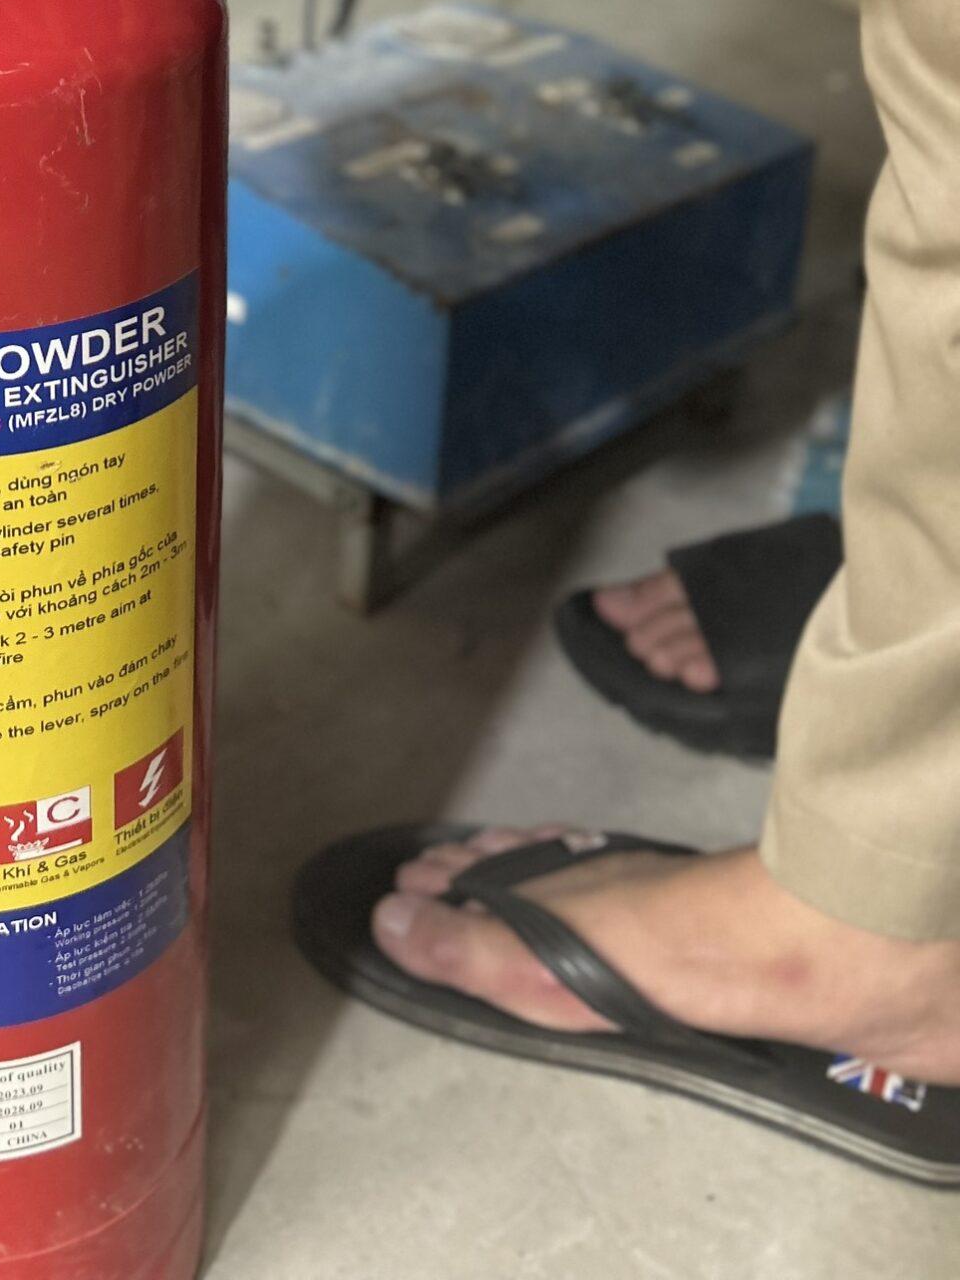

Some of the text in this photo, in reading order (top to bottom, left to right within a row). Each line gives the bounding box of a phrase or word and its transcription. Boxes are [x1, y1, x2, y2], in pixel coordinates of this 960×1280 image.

[4, 331, 188, 408] EXTINGUISHER
[8, 402, 87, 432] (MFZL8)
[92, 387, 128, 412] DRY
[132, 354, 191, 397] POWDER
[8, 474, 52, 490] dùng
[104, 453, 125, 468] tay
[3, 499, 24, 511] an
[30, 490, 67, 507] toàn
[56, 503, 115, 529] several
[50, 533, 75, 553] pin
[21, 582, 63, 603] phun
[92, 562, 125, 586] phía
[102, 573, 137, 596] cách
[140, 560, 160, 579] 2m
[16, 632, 27, 645] 2
[43, 626, 55, 640] 3
[59, 613, 106, 637] metre
[110, 600, 136, 619] aim
[139, 589, 152, 605] at
[8, 724, 35, 739] the
[40, 711, 85, 734] lever,
[90, 691, 131, 718] spray
[133, 682, 149, 697] on
[152, 667, 171, 686] the
[43, 684, 83, 708] phun
[87, 671, 115, 691] vào
[47, 796, 80, 823] C
[3, 851, 87, 880] Khí & Gas
[41, 874, 60, 883] Gas
[73, 856, 105, 874] Vapors
[0, 1071, 13, 1083] of
[17, 1061, 66, 1082] quality
[7, 1131, 48, 1147] CHINA
[9, 1121, 23, 1131] 01
